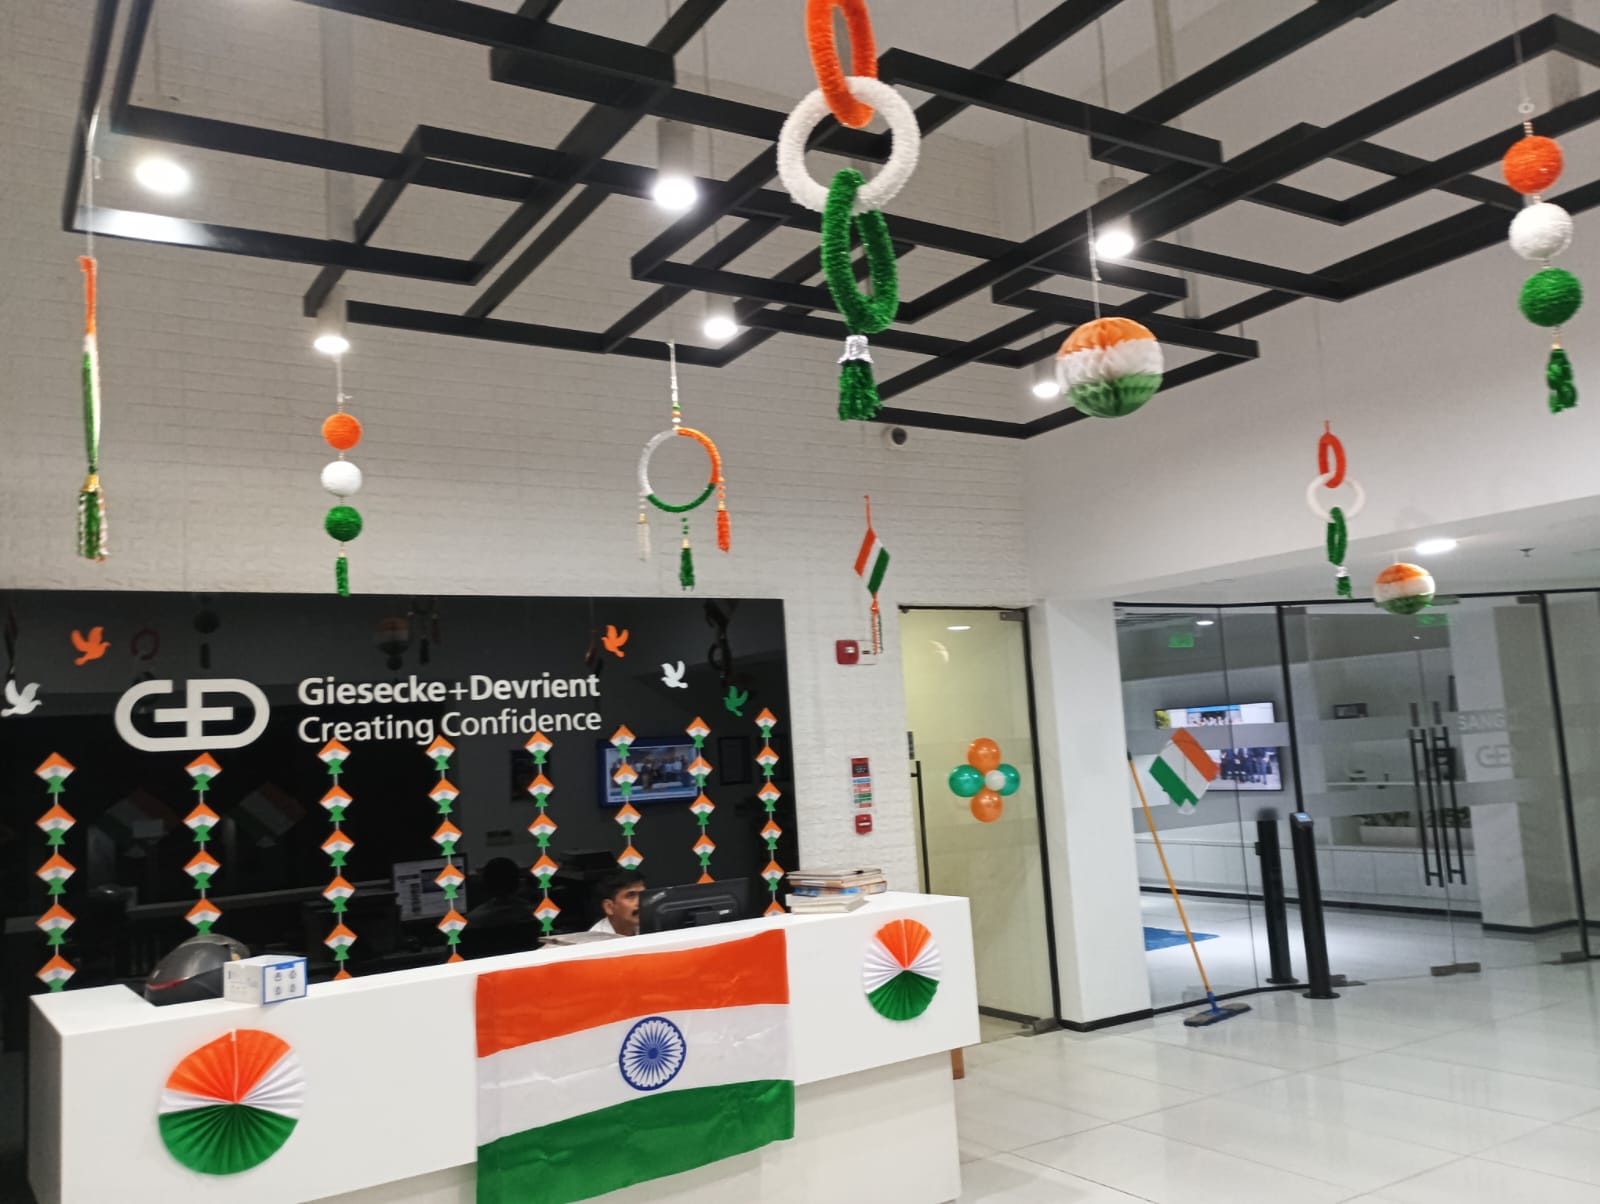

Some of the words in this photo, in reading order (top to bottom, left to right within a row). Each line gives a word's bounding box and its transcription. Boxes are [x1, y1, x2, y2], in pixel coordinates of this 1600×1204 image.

[298, 672, 601, 705] Giesecke+Devrient
[298, 714, 434, 745] Creating
[441, 708, 602, 737] Confidence
